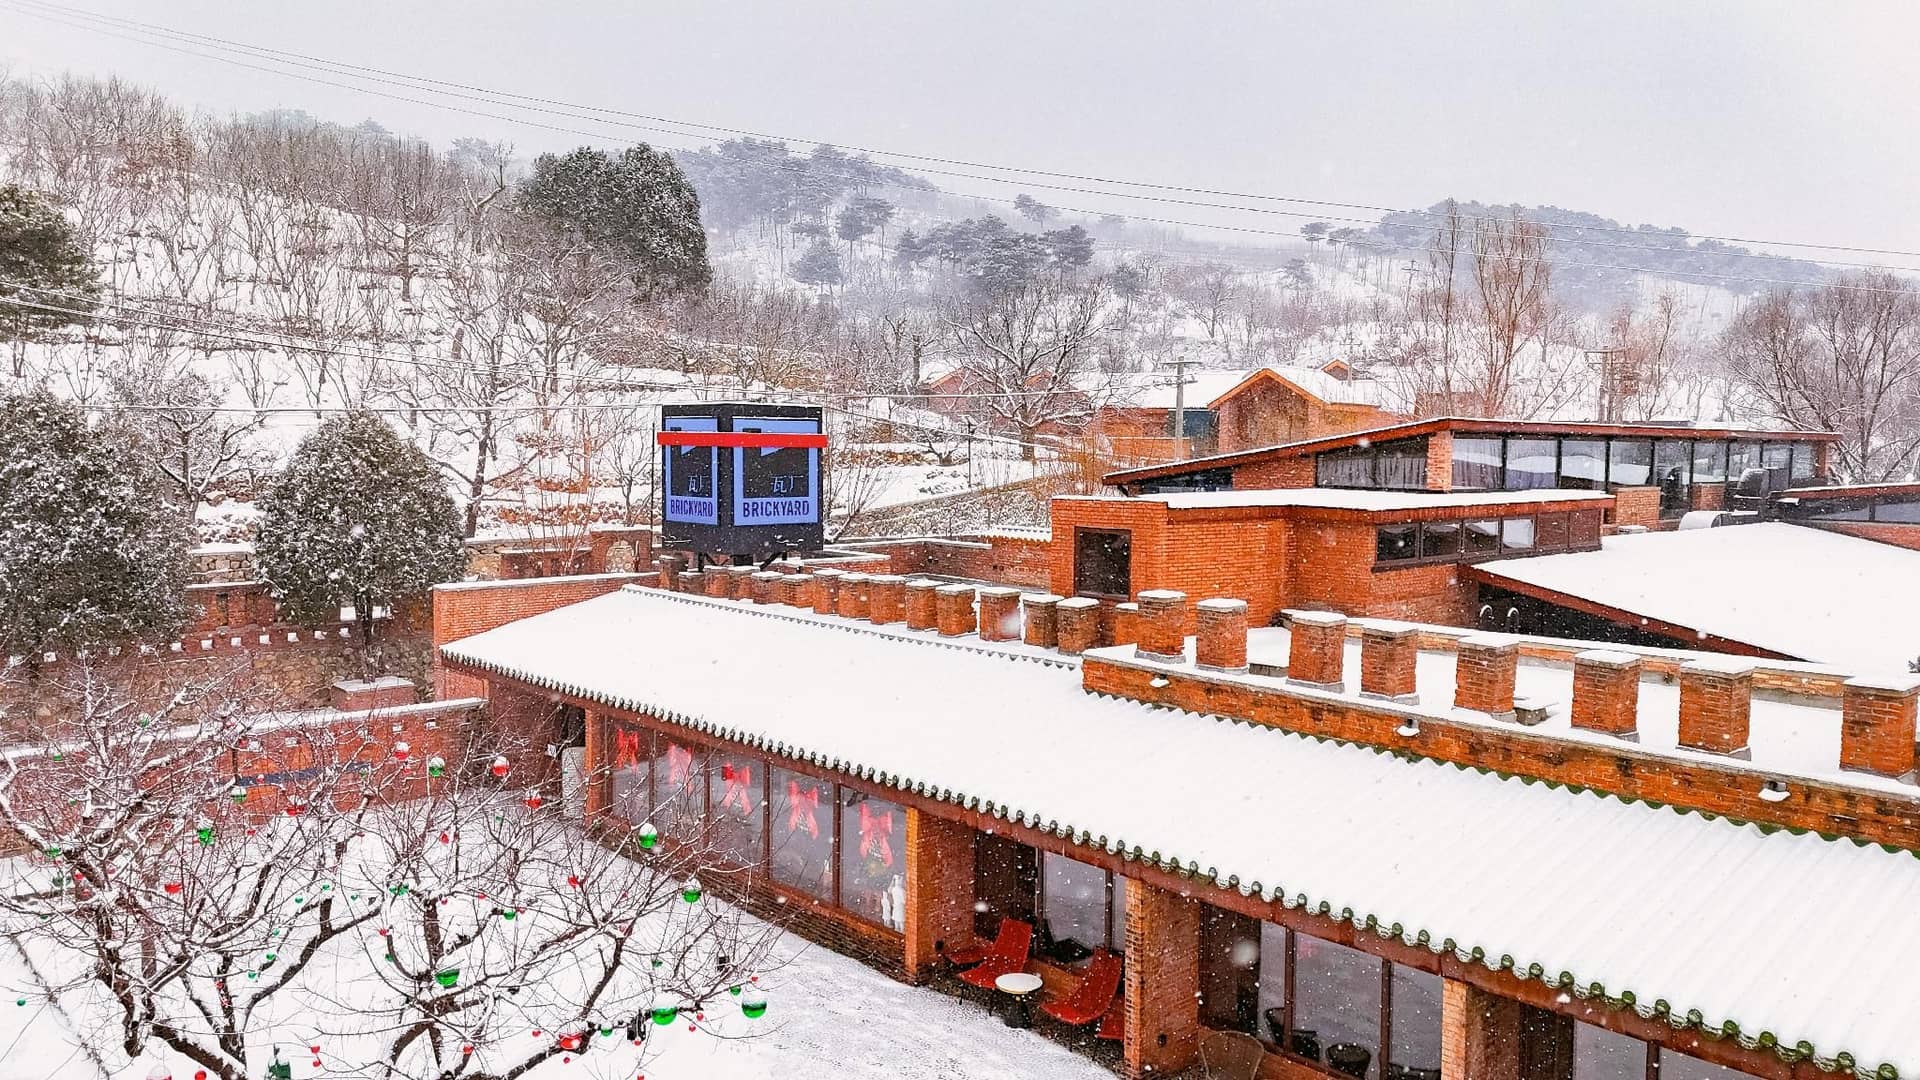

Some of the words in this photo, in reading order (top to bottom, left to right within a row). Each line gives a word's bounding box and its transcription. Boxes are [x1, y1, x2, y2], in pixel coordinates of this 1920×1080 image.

[771, 475, 804, 493] 瓦厂
[670, 499, 713, 517] BRICKYARD
[743, 500, 810, 518] BRICKYARD
